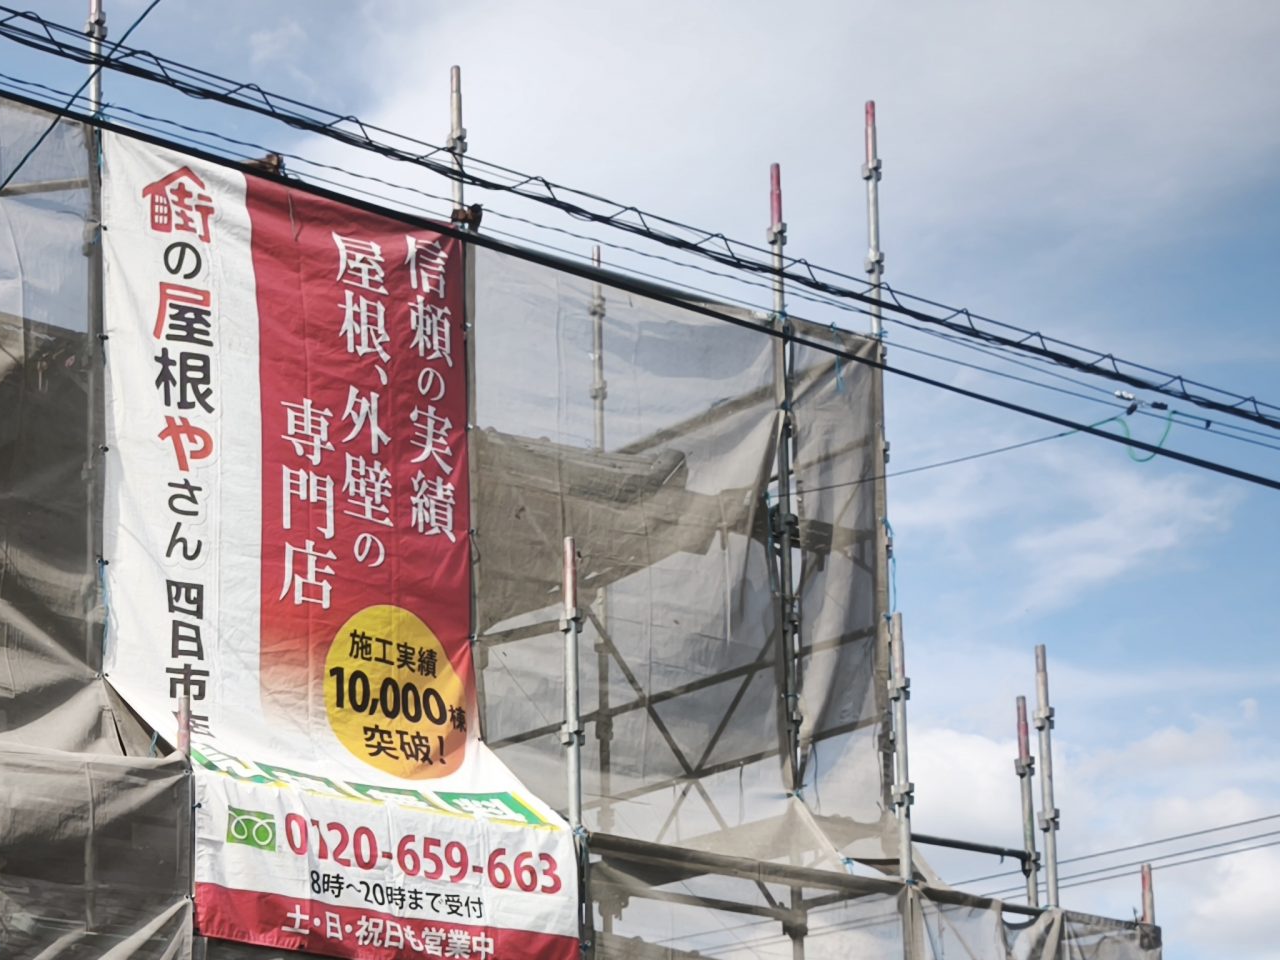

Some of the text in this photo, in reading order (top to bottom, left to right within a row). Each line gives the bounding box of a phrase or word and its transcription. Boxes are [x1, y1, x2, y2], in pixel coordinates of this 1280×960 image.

[331, 231, 394, 568] 屋根、外壁の
[404, 234, 457, 543] 信頼の実績
[279, 398, 338, 610] 専門店
[349, 629, 438, 679] 施工実績
[284, 812, 562, 894] 0120-659-663
